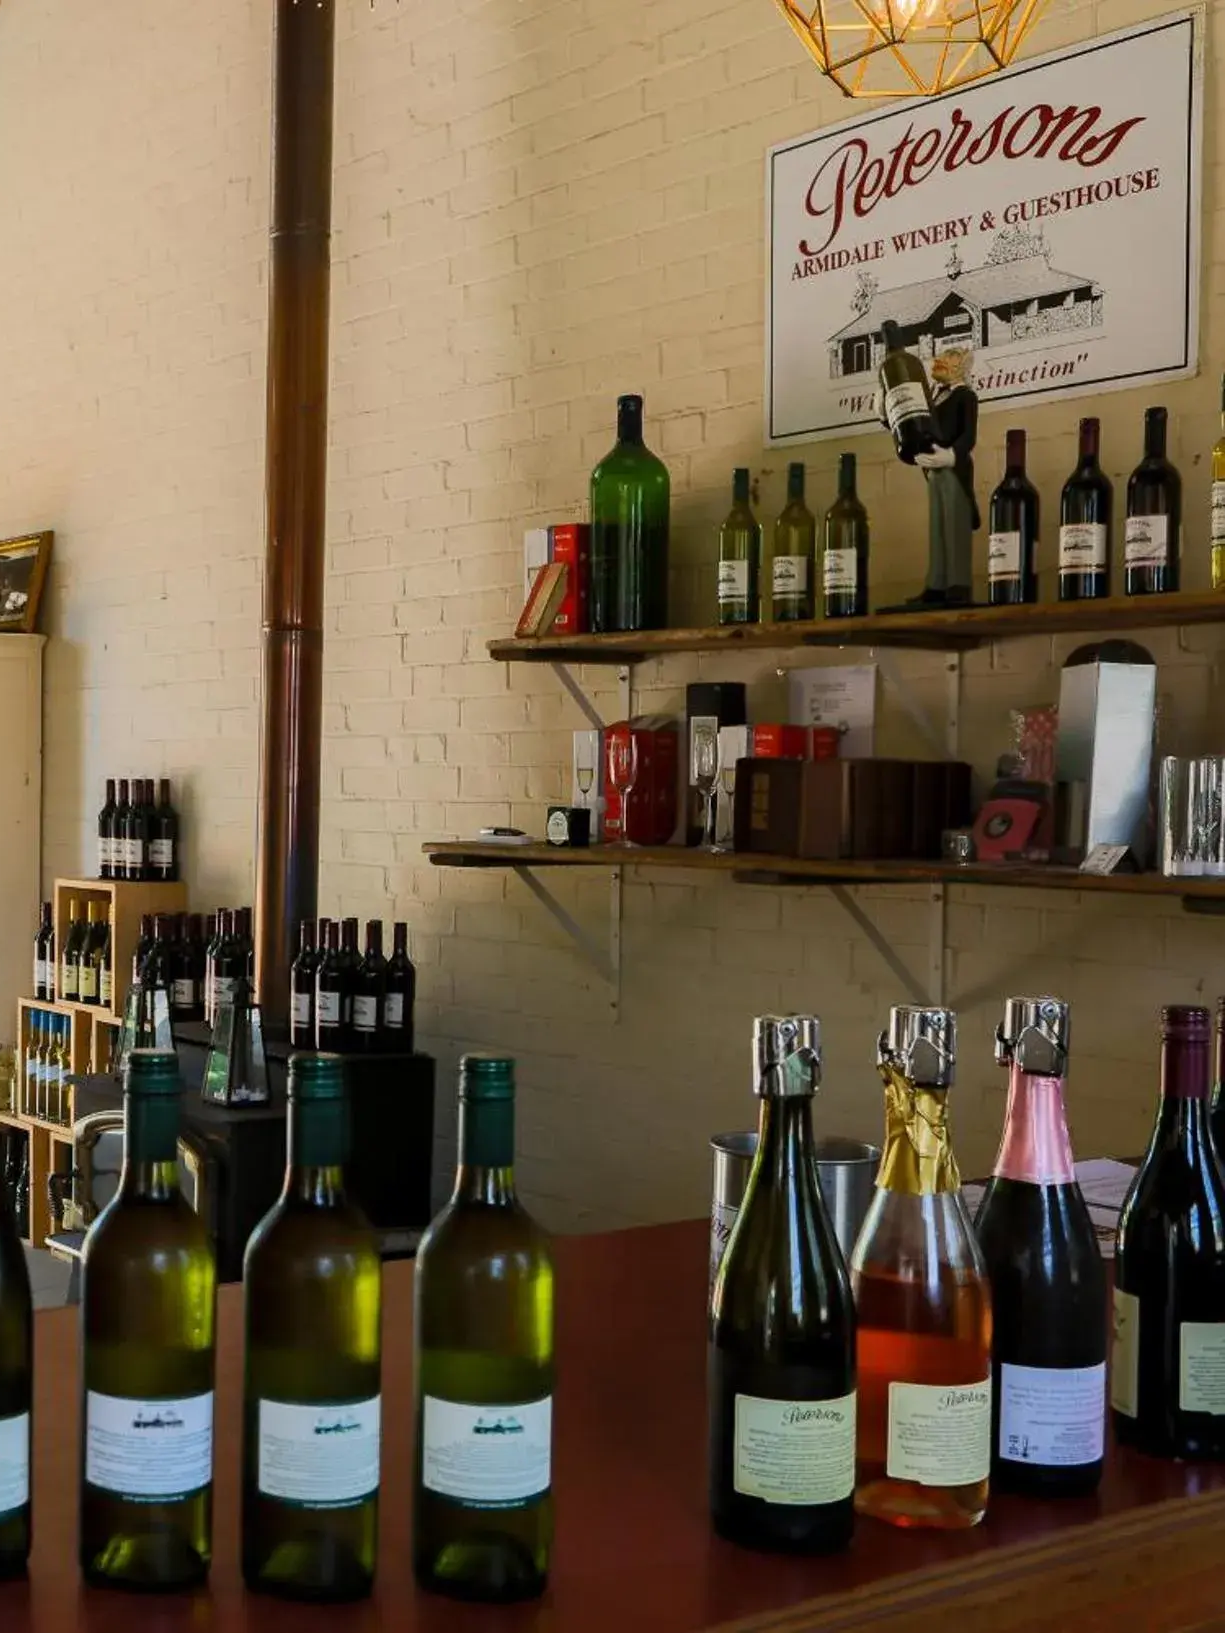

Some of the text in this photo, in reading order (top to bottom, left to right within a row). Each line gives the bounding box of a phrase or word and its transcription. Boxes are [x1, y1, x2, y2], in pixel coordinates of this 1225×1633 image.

[791, 167, 1161, 281] ARMIDALE WINERY & GUESTHOUSE
[799, 104, 1147, 257] Petersons
